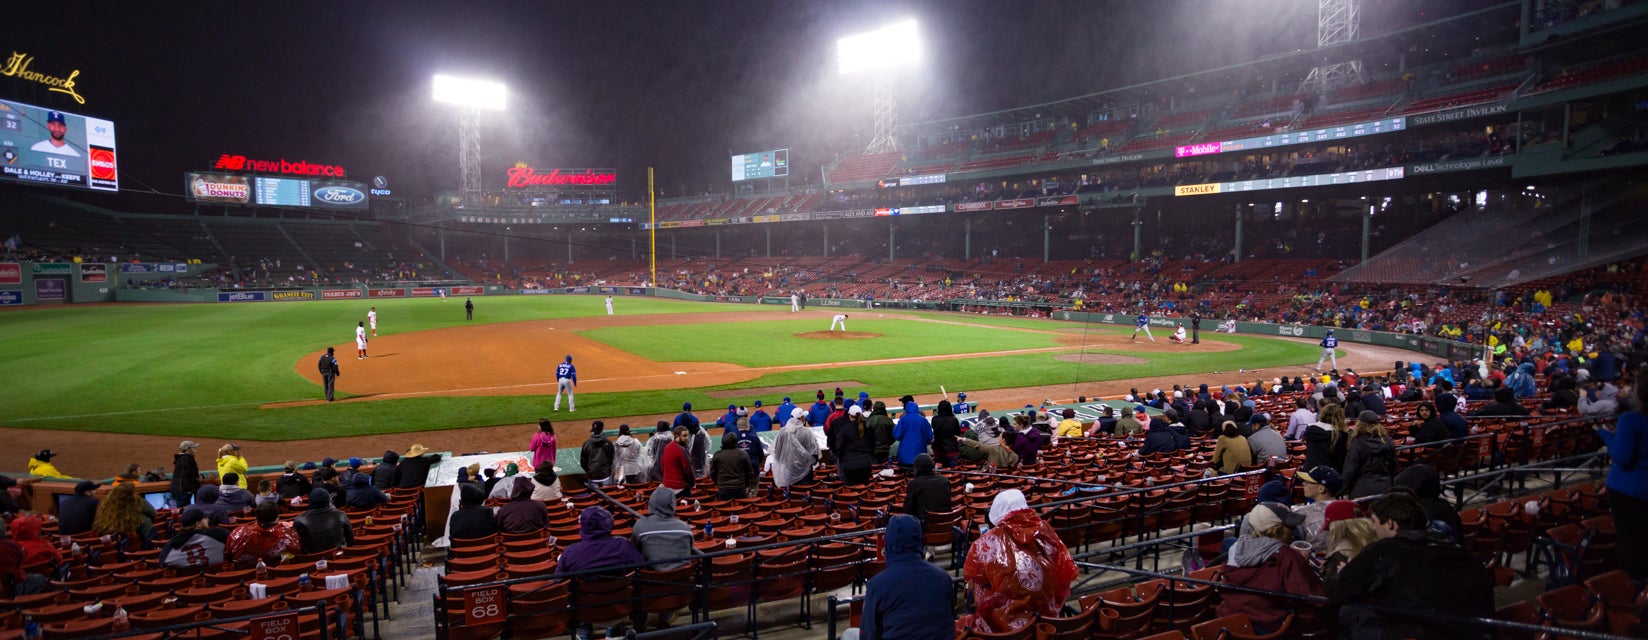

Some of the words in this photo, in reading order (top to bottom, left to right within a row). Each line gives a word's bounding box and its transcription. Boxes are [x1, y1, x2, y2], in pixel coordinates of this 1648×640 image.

[1, 51, 86, 105] Hancock
[1415, 116, 1435, 125] STATE
[1437, 111, 1464, 121] STREET
[1466, 104, 1508, 118] PAVILION
[6, 121, 17, 129] 32
[46, 157, 67, 169] TEX
[246, 159, 280, 171] new
[281, 158, 344, 177] balance
[1414, 165, 1435, 174] DELL
[1435, 161, 1481, 172] Technologies
[1483, 158, 1504, 166] Level
[4, 166, 22, 175] DALE
[29, 169, 55, 178] HOLLEY
[1388, 168, 1404, 177] 9TH
[507, 167, 616, 188] Budweiser
[209, 183, 247, 192] DUNKIN'
[370, 188, 391, 196] tyco
[1180, 186, 1216, 194] STANLEY
[210, 189, 245, 198] DONUTS
[324, 188, 355, 202] Ford
[229, 292, 255, 301] jetBlue
[301, 291, 314, 300] CITY
[377, 289, 396, 297] xfinity
[559, 367, 569, 376] 27
[1248, 484, 1259, 494] 65
[472, 589, 498, 598] FIELD
[475, 596, 495, 604] BOX
[472, 604, 499, 618] 68
[260, 619, 290, 629] FIELD
[265, 626, 287, 635] BOX
